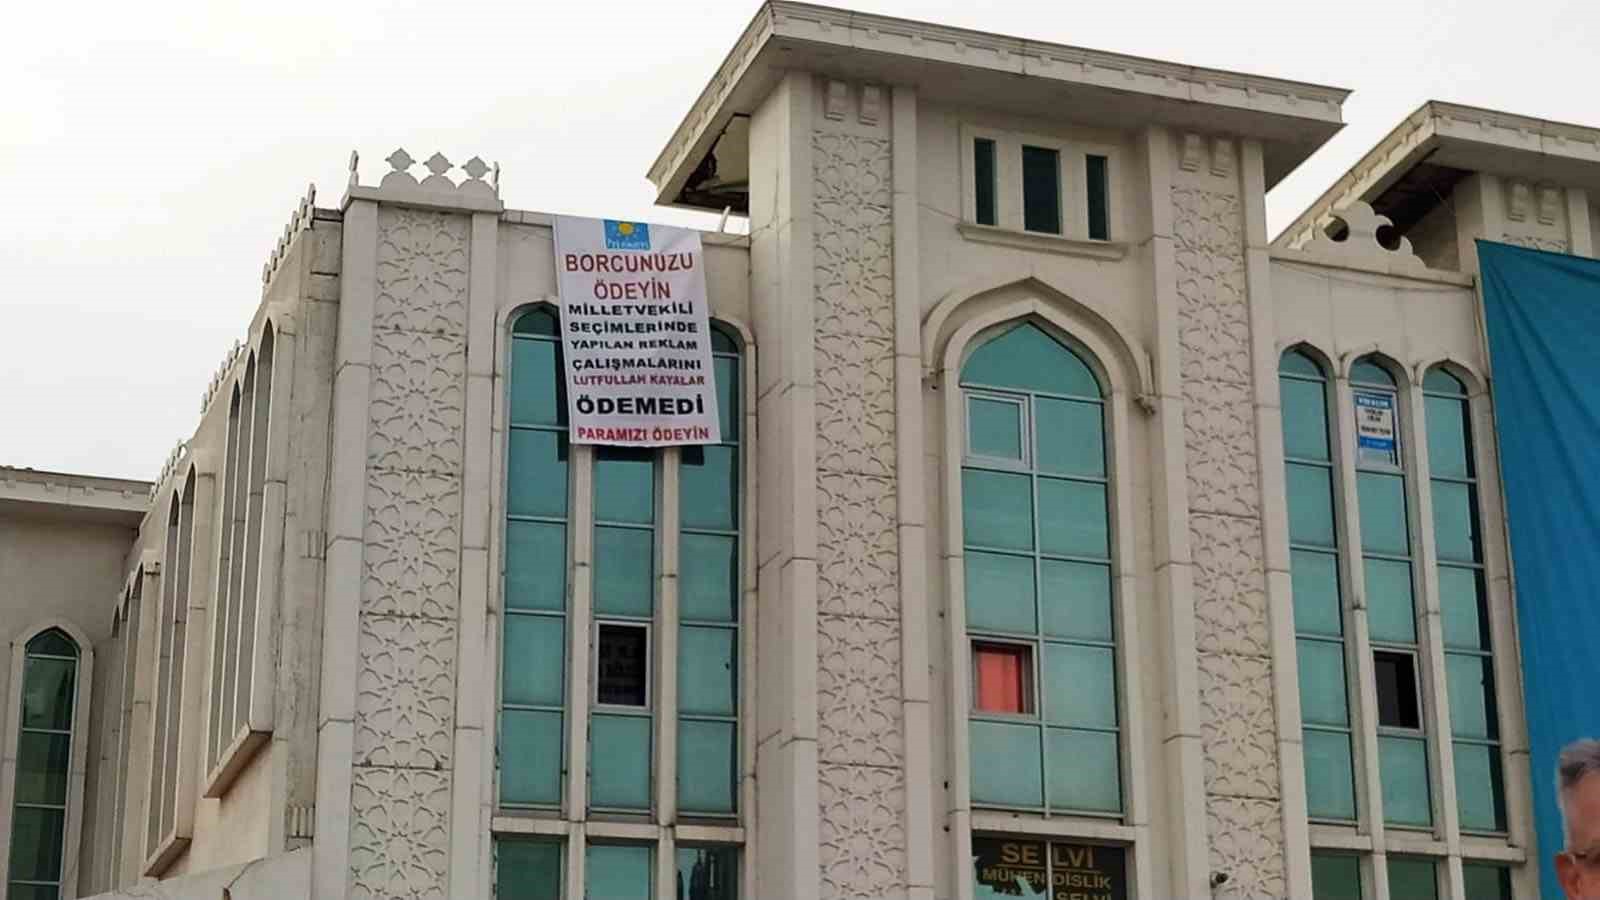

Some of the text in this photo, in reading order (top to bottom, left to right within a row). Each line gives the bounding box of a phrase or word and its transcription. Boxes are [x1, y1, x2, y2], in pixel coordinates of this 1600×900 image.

[565, 252, 694, 273] BORCUNUZU
[593, 277, 671, 300] ÖDEYİN
[568, 301, 693, 316] MİLLETVEKİLİ
[569, 320, 698, 334] SEÇİMLERİNDE
[570, 339, 698, 350] YAPILAN REKLAM
[572, 357, 701, 371] ÇALIŞMALARINI
[650, 375, 705, 386] KAYALAR
[576, 393, 704, 415] ÖDEMEDİ
[577, 425, 710, 442] PARAMIZI ÖDEYİN
